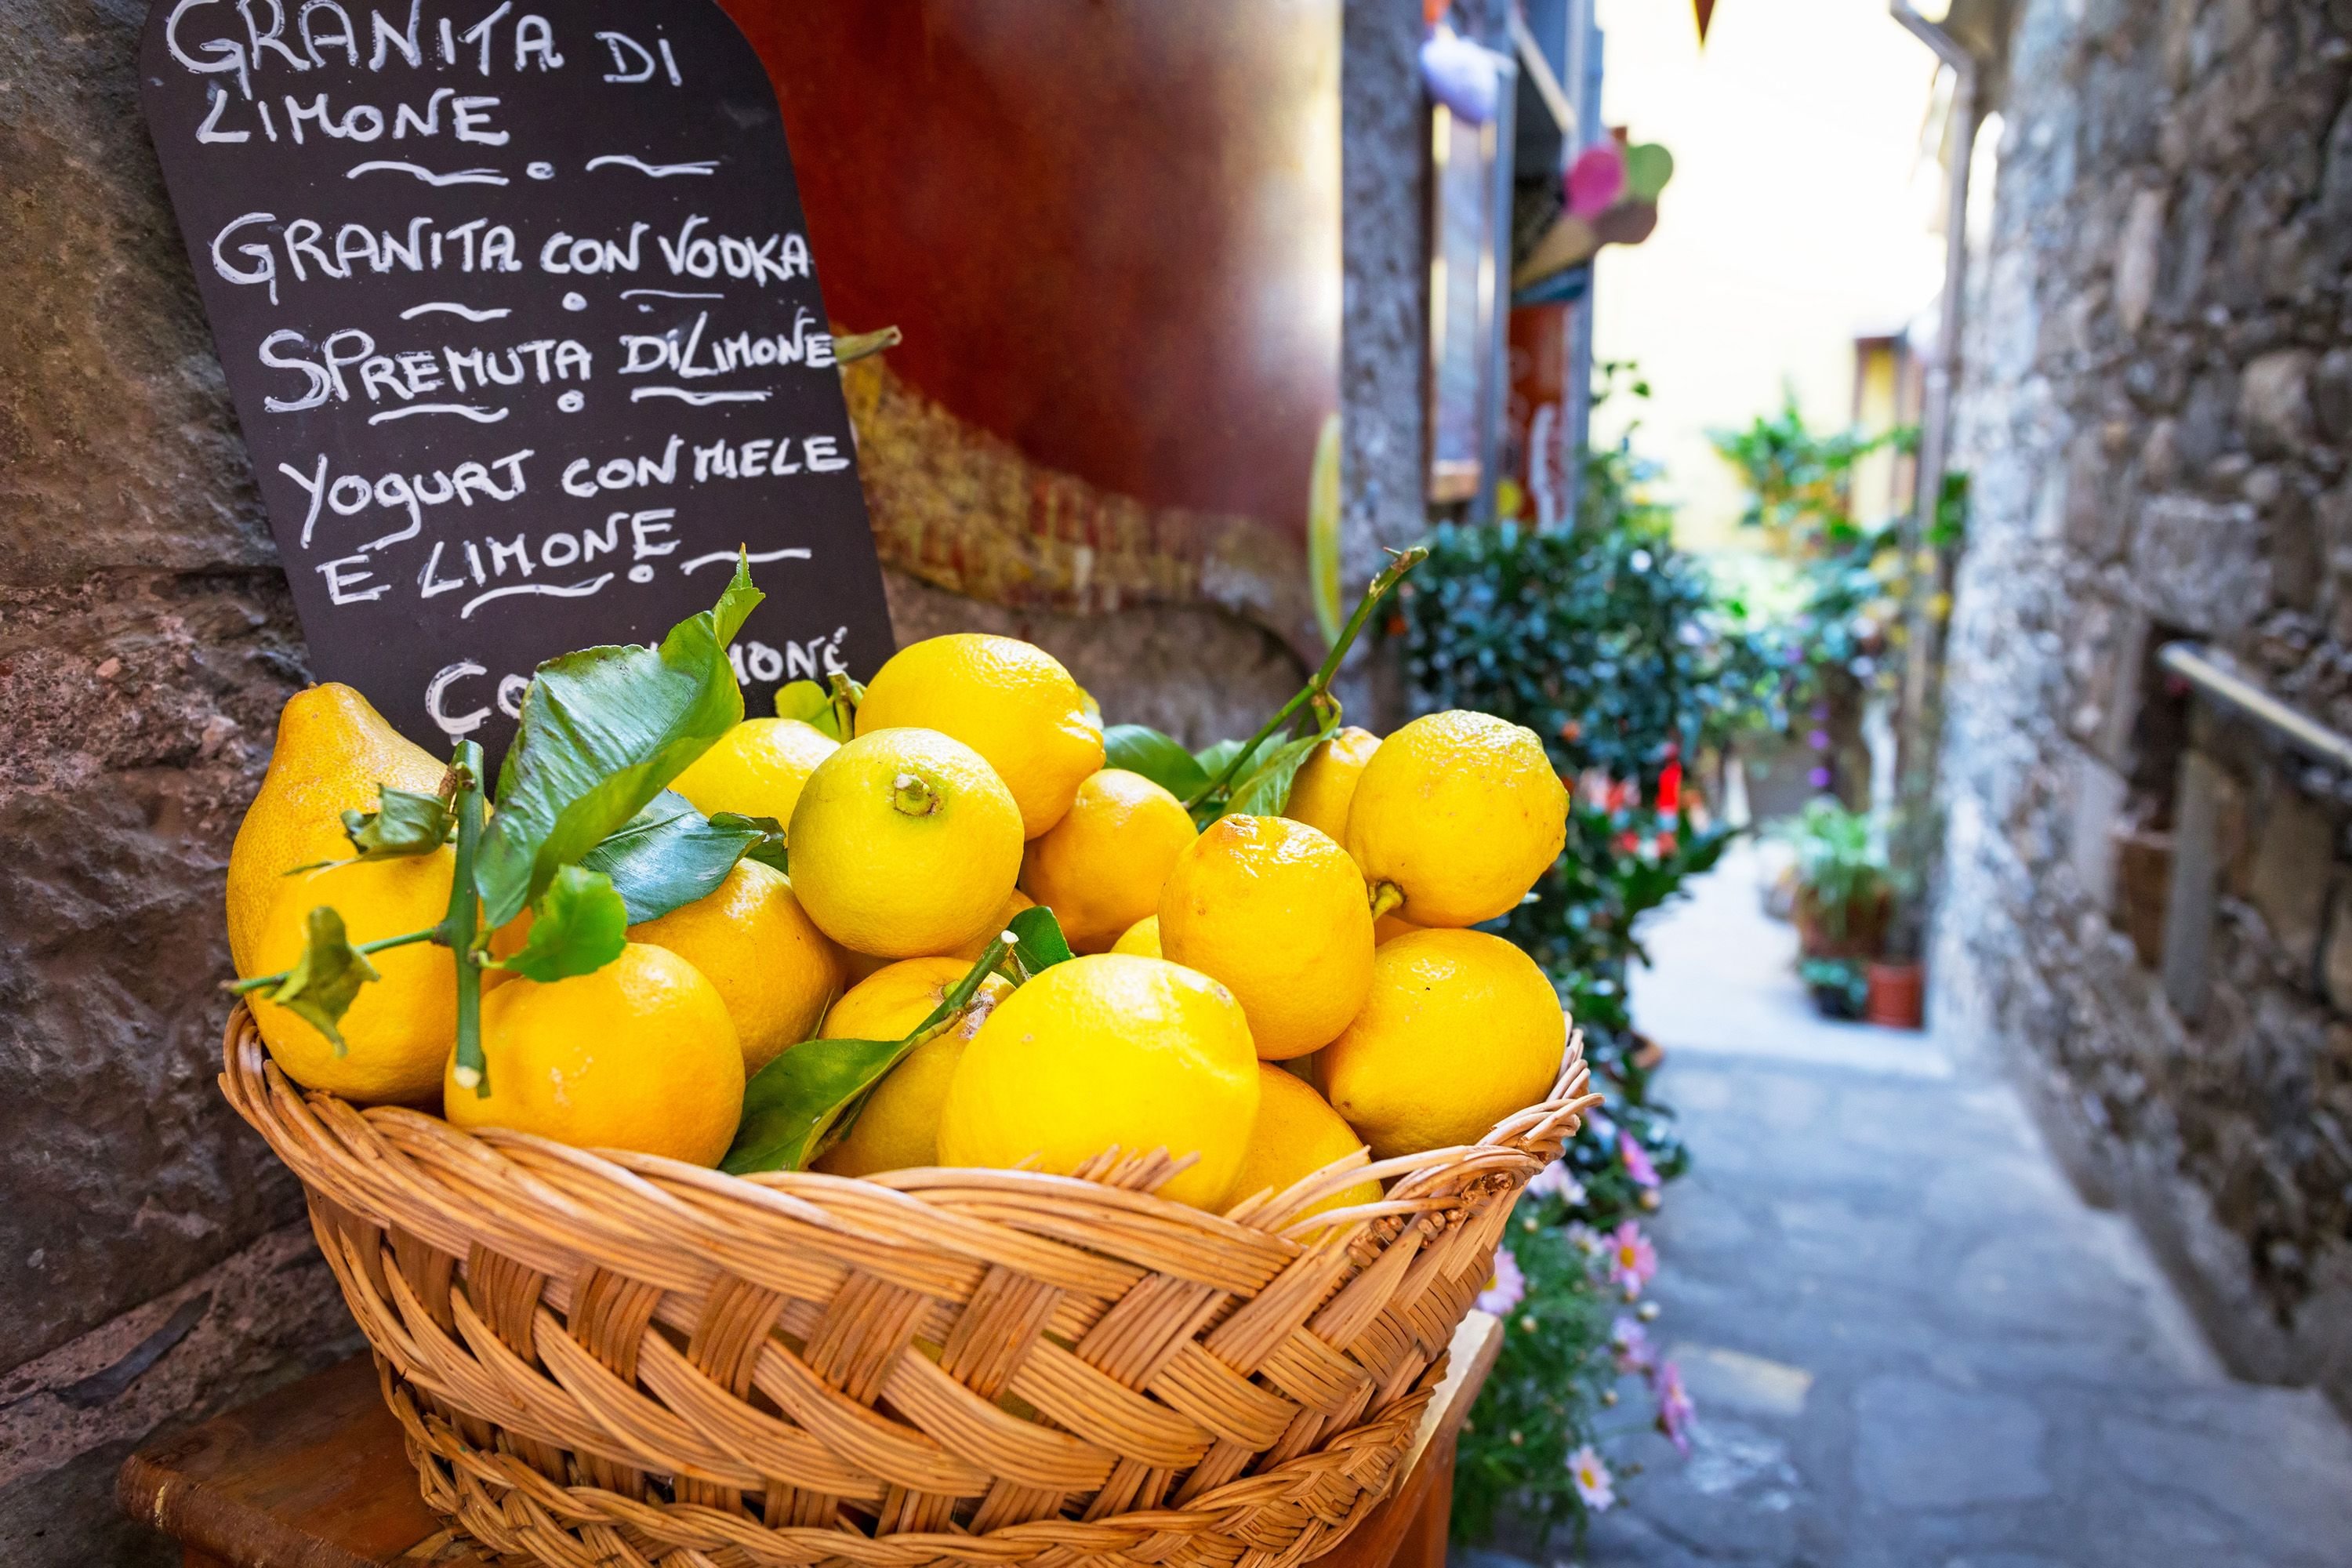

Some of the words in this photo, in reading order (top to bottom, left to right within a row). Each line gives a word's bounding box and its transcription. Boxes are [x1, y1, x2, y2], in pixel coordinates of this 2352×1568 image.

[165, 0, 564, 100] GRANITA
[196, 85, 510, 147] LIMONE
[208, 212, 523, 305] GRANITA
[539, 220, 650, 274] CON
[656, 214, 812, 287] VODKA
[258, 327, 593, 414] SPREMUTA
[561, 434, 684, 498] CON
[315, 554, 391, 606] E
[417, 508, 681, 600] LIMONE
